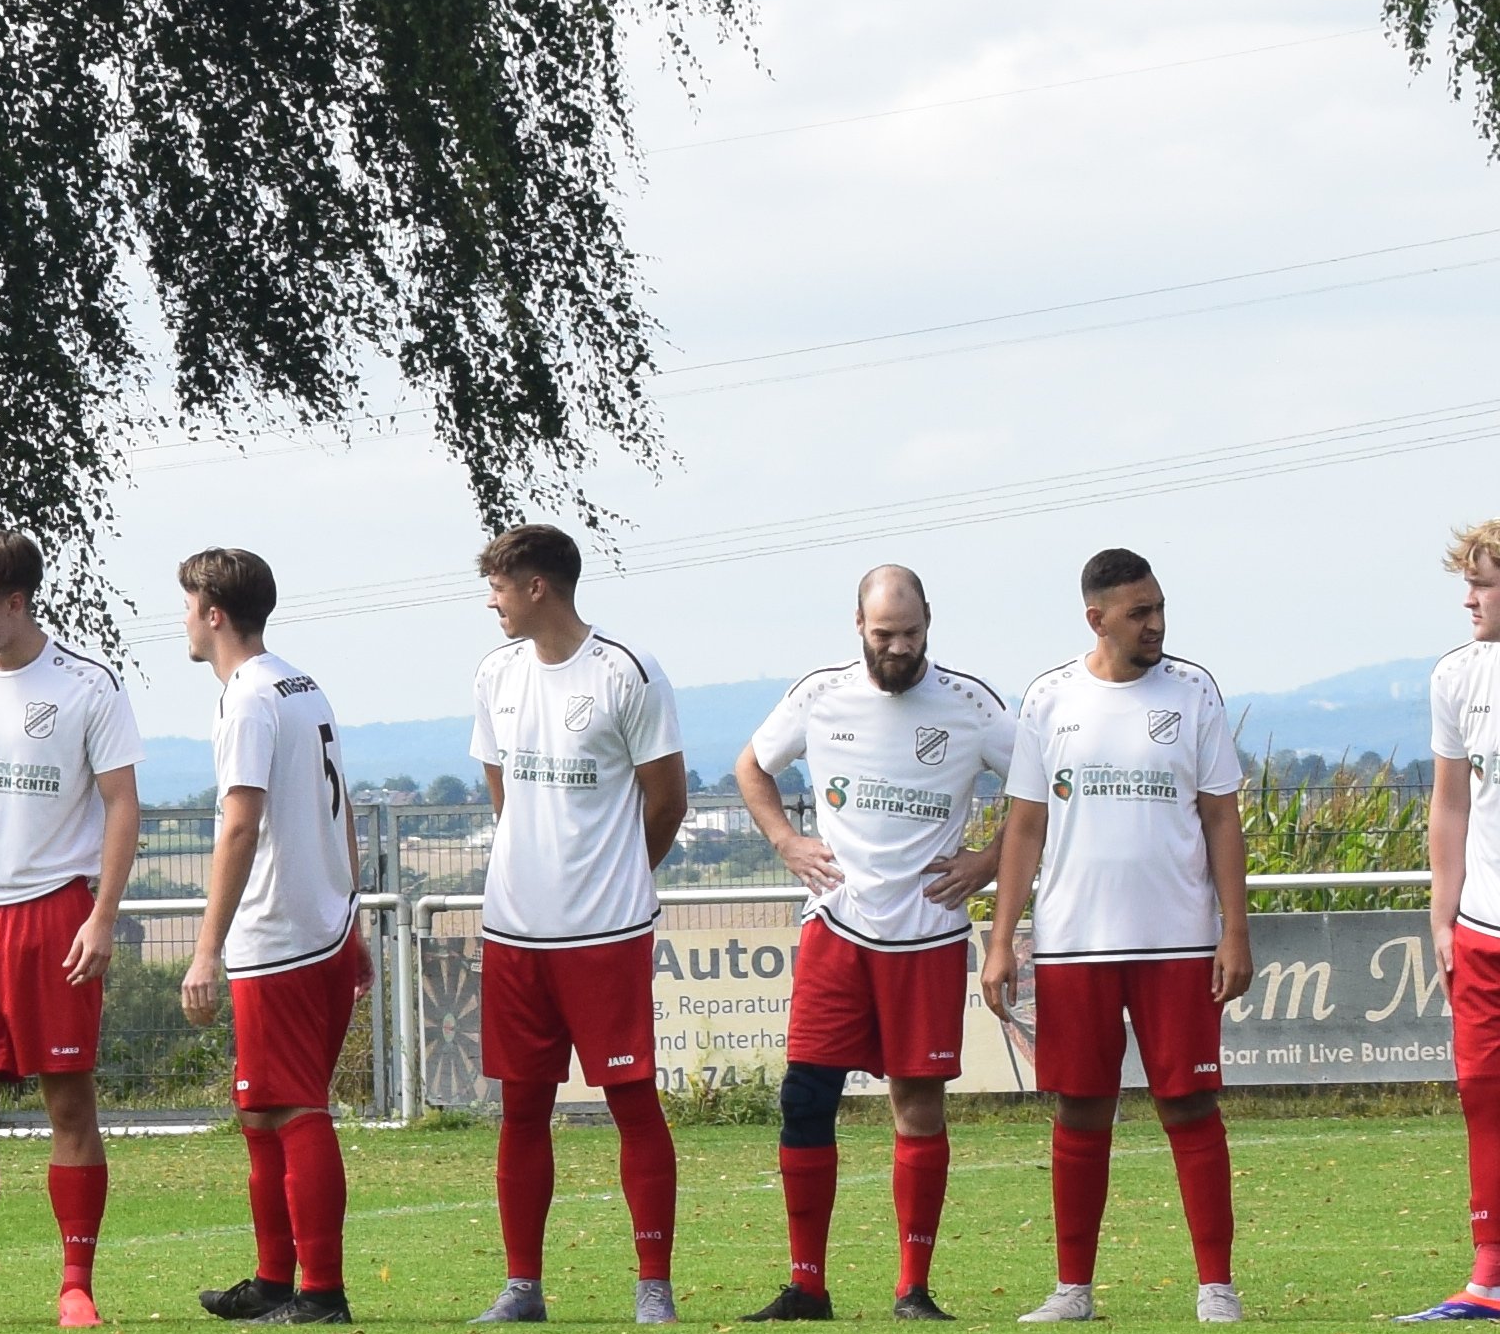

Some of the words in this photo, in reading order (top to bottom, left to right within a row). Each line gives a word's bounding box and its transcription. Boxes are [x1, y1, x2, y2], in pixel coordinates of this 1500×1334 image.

[1057, 724, 1080, 735] JAKO
[830, 733, 855, 741] JAKO
[318, 723, 341, 821] 5
[1082, 784, 1178, 798] GARTEN-CENTER
[856, 798, 950, 819] GARTEN-CENTER
[696, 1028, 786, 1050] Unterha
[1267, 1044, 1301, 1064] mit
[1309, 1043, 1354, 1064] Live
[1361, 1042, 1451, 1063] Bundesl
[607, 1055, 634, 1067] JAKO
[66, 1235, 96, 1245] JAKO
[635, 1231, 662, 1240] JAKO
[906, 1233, 933, 1245] JAKO
